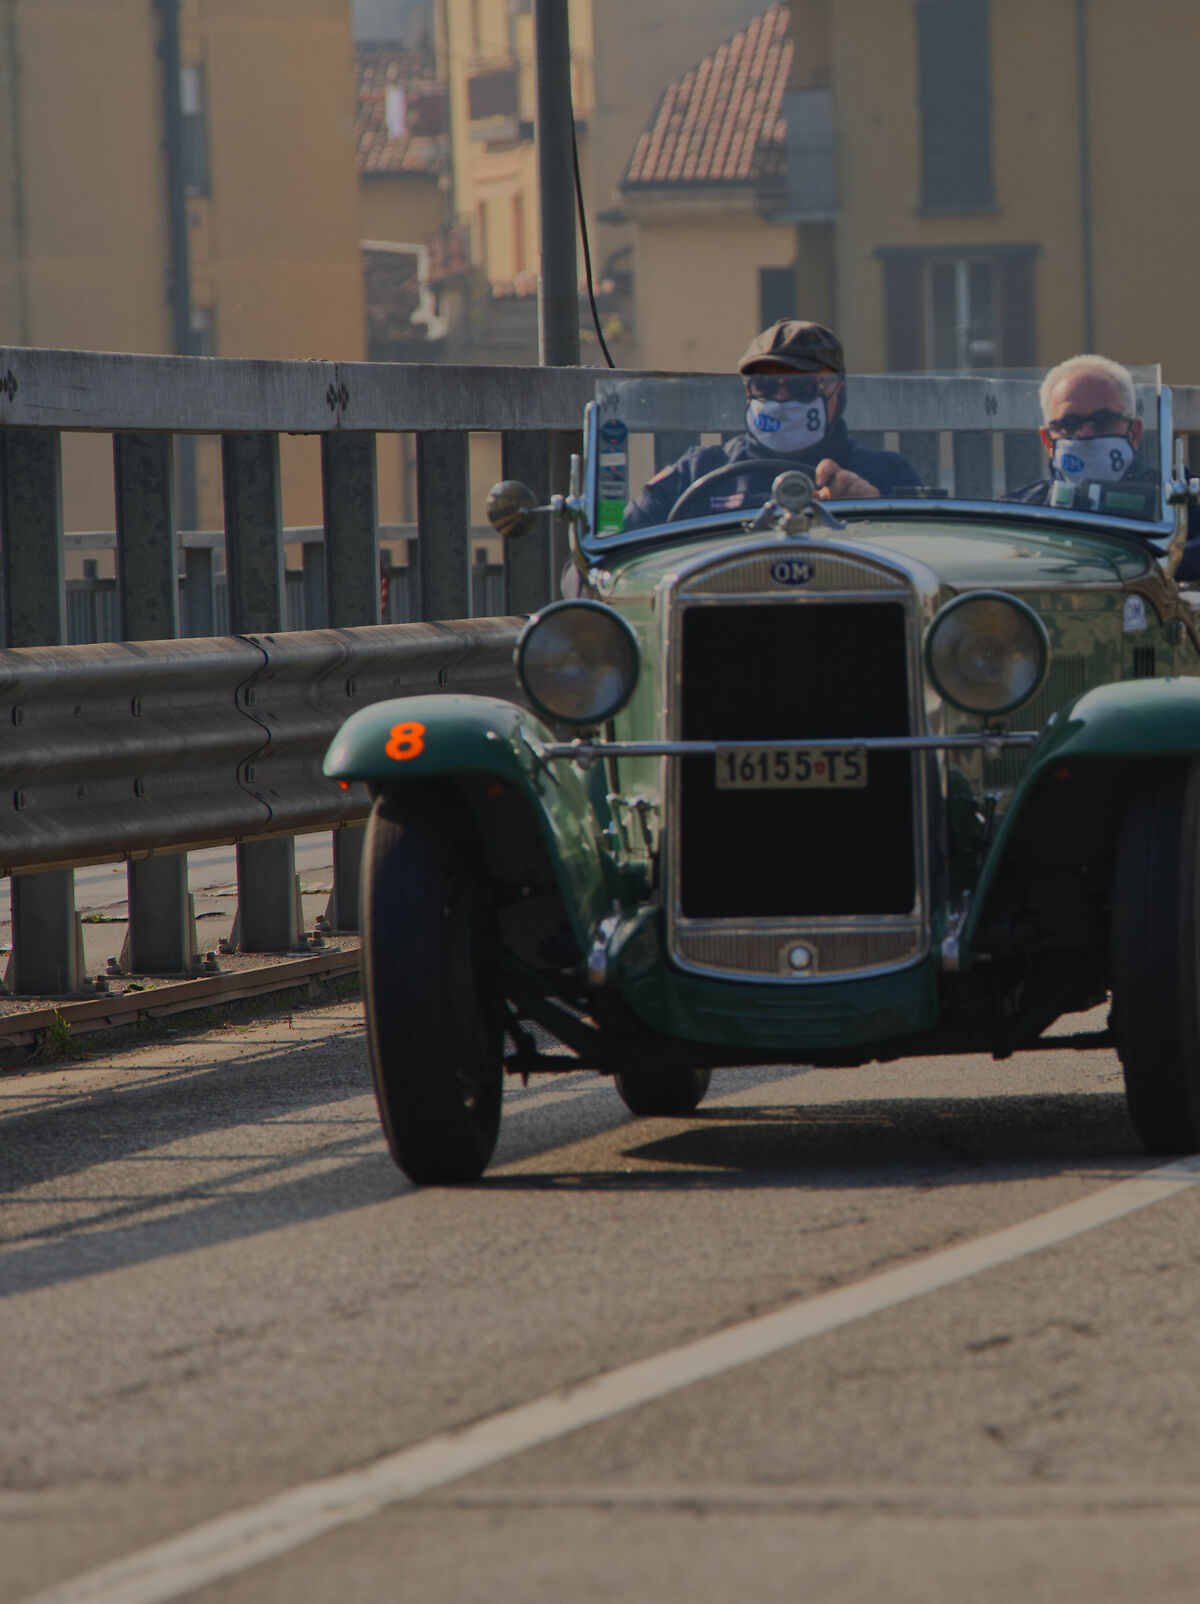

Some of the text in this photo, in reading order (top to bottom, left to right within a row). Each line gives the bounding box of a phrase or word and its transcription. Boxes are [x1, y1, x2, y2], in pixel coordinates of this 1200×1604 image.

[807, 408, 820, 431] 8
[1109, 449, 1124, 472] 8
[774, 562, 809, 581] OM
[385, 721, 426, 760] 8
[726, 749, 863, 782] 16155 TS
